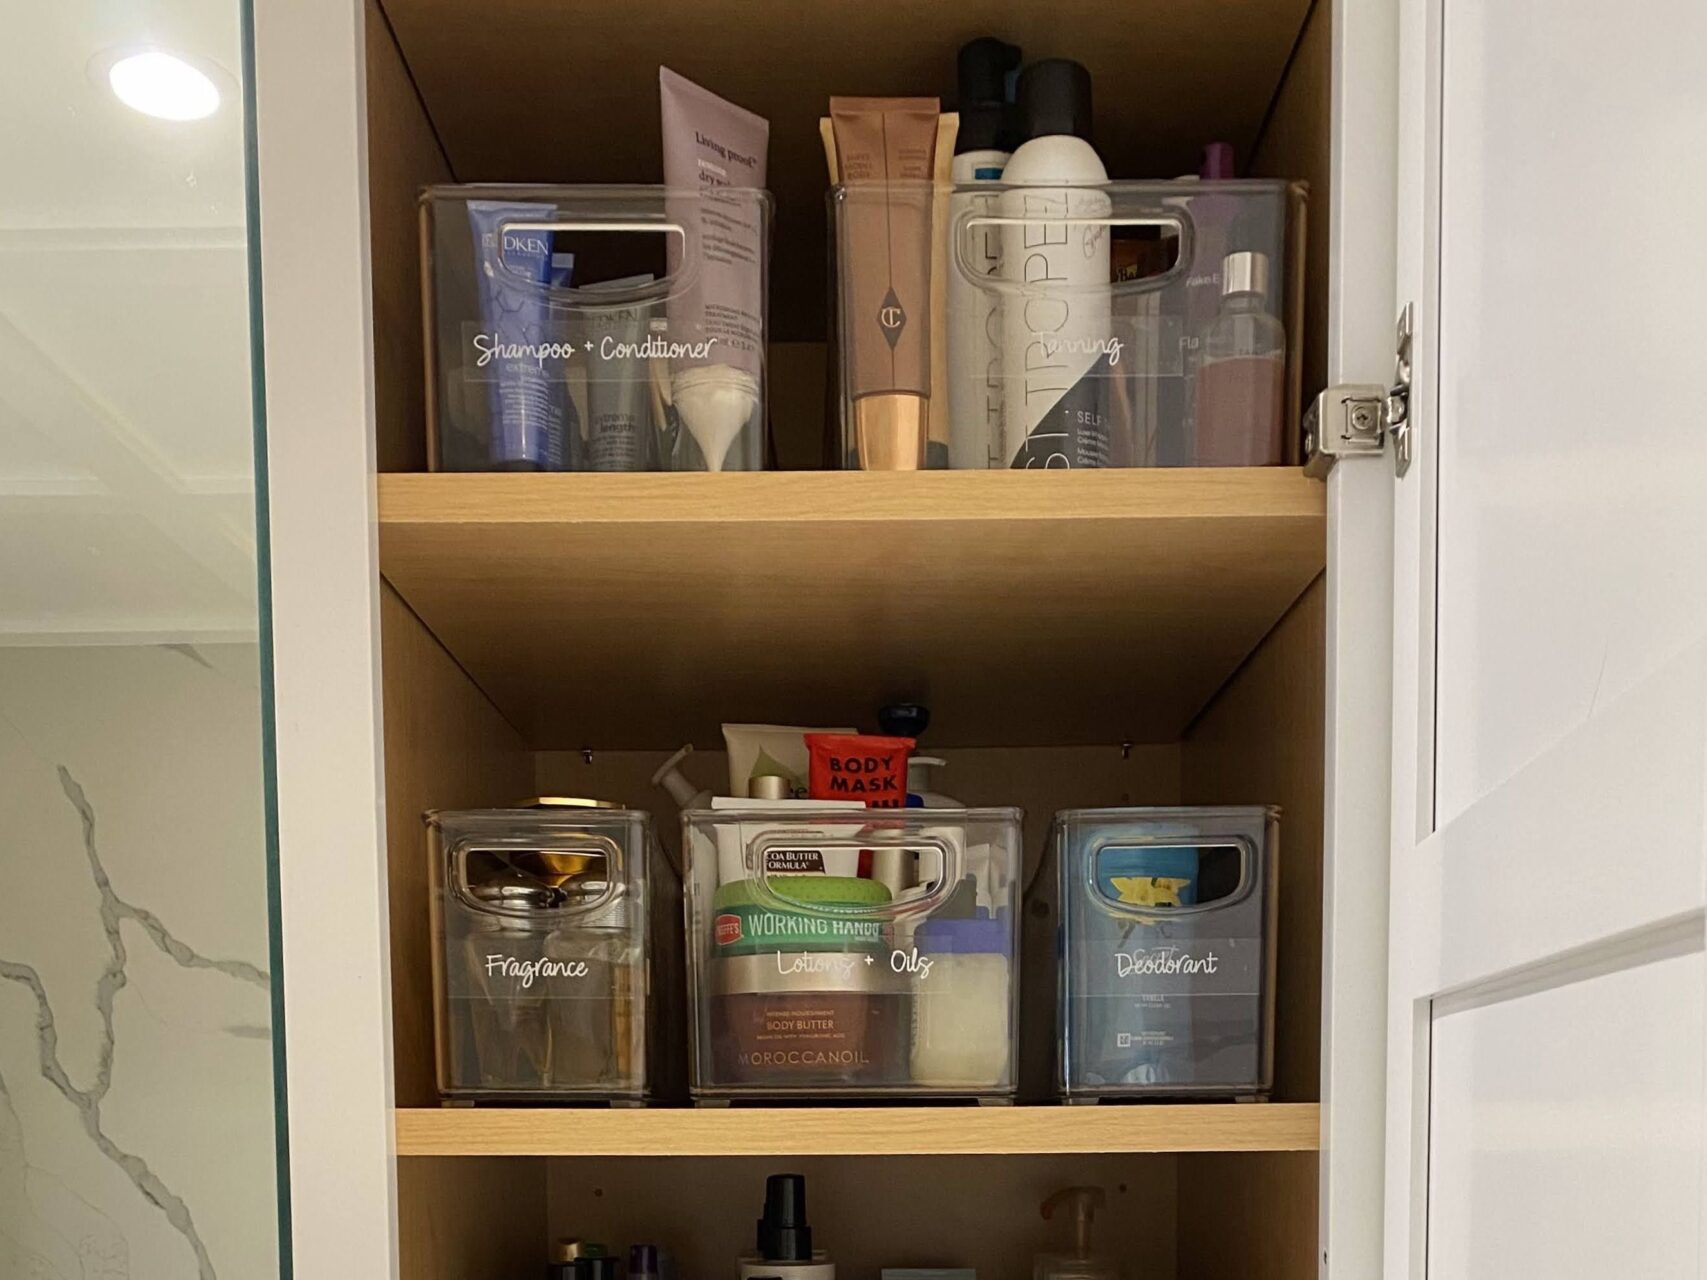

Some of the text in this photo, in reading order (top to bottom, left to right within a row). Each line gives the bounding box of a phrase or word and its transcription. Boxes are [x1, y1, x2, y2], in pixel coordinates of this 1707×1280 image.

[474, 334, 718, 368] Shampoo + Conditioner
[1031, 331, 1124, 366] Tanning
[830, 756, 892, 773] BODY
[831, 774, 897, 793] MASK
[768, 861, 806, 869] ORMULA
[786, 851, 819, 860] BUTTER
[749, 912, 828, 936] WORKING
[485, 955, 588, 988] Fragrance
[777, 947, 935, 980] Lotions + Oils
[1114, 952, 1218, 978] Deodorant
[767, 1019, 834, 1030] BODY BUTTER
[737, 1050, 870, 1066] MOROCCANOIL
